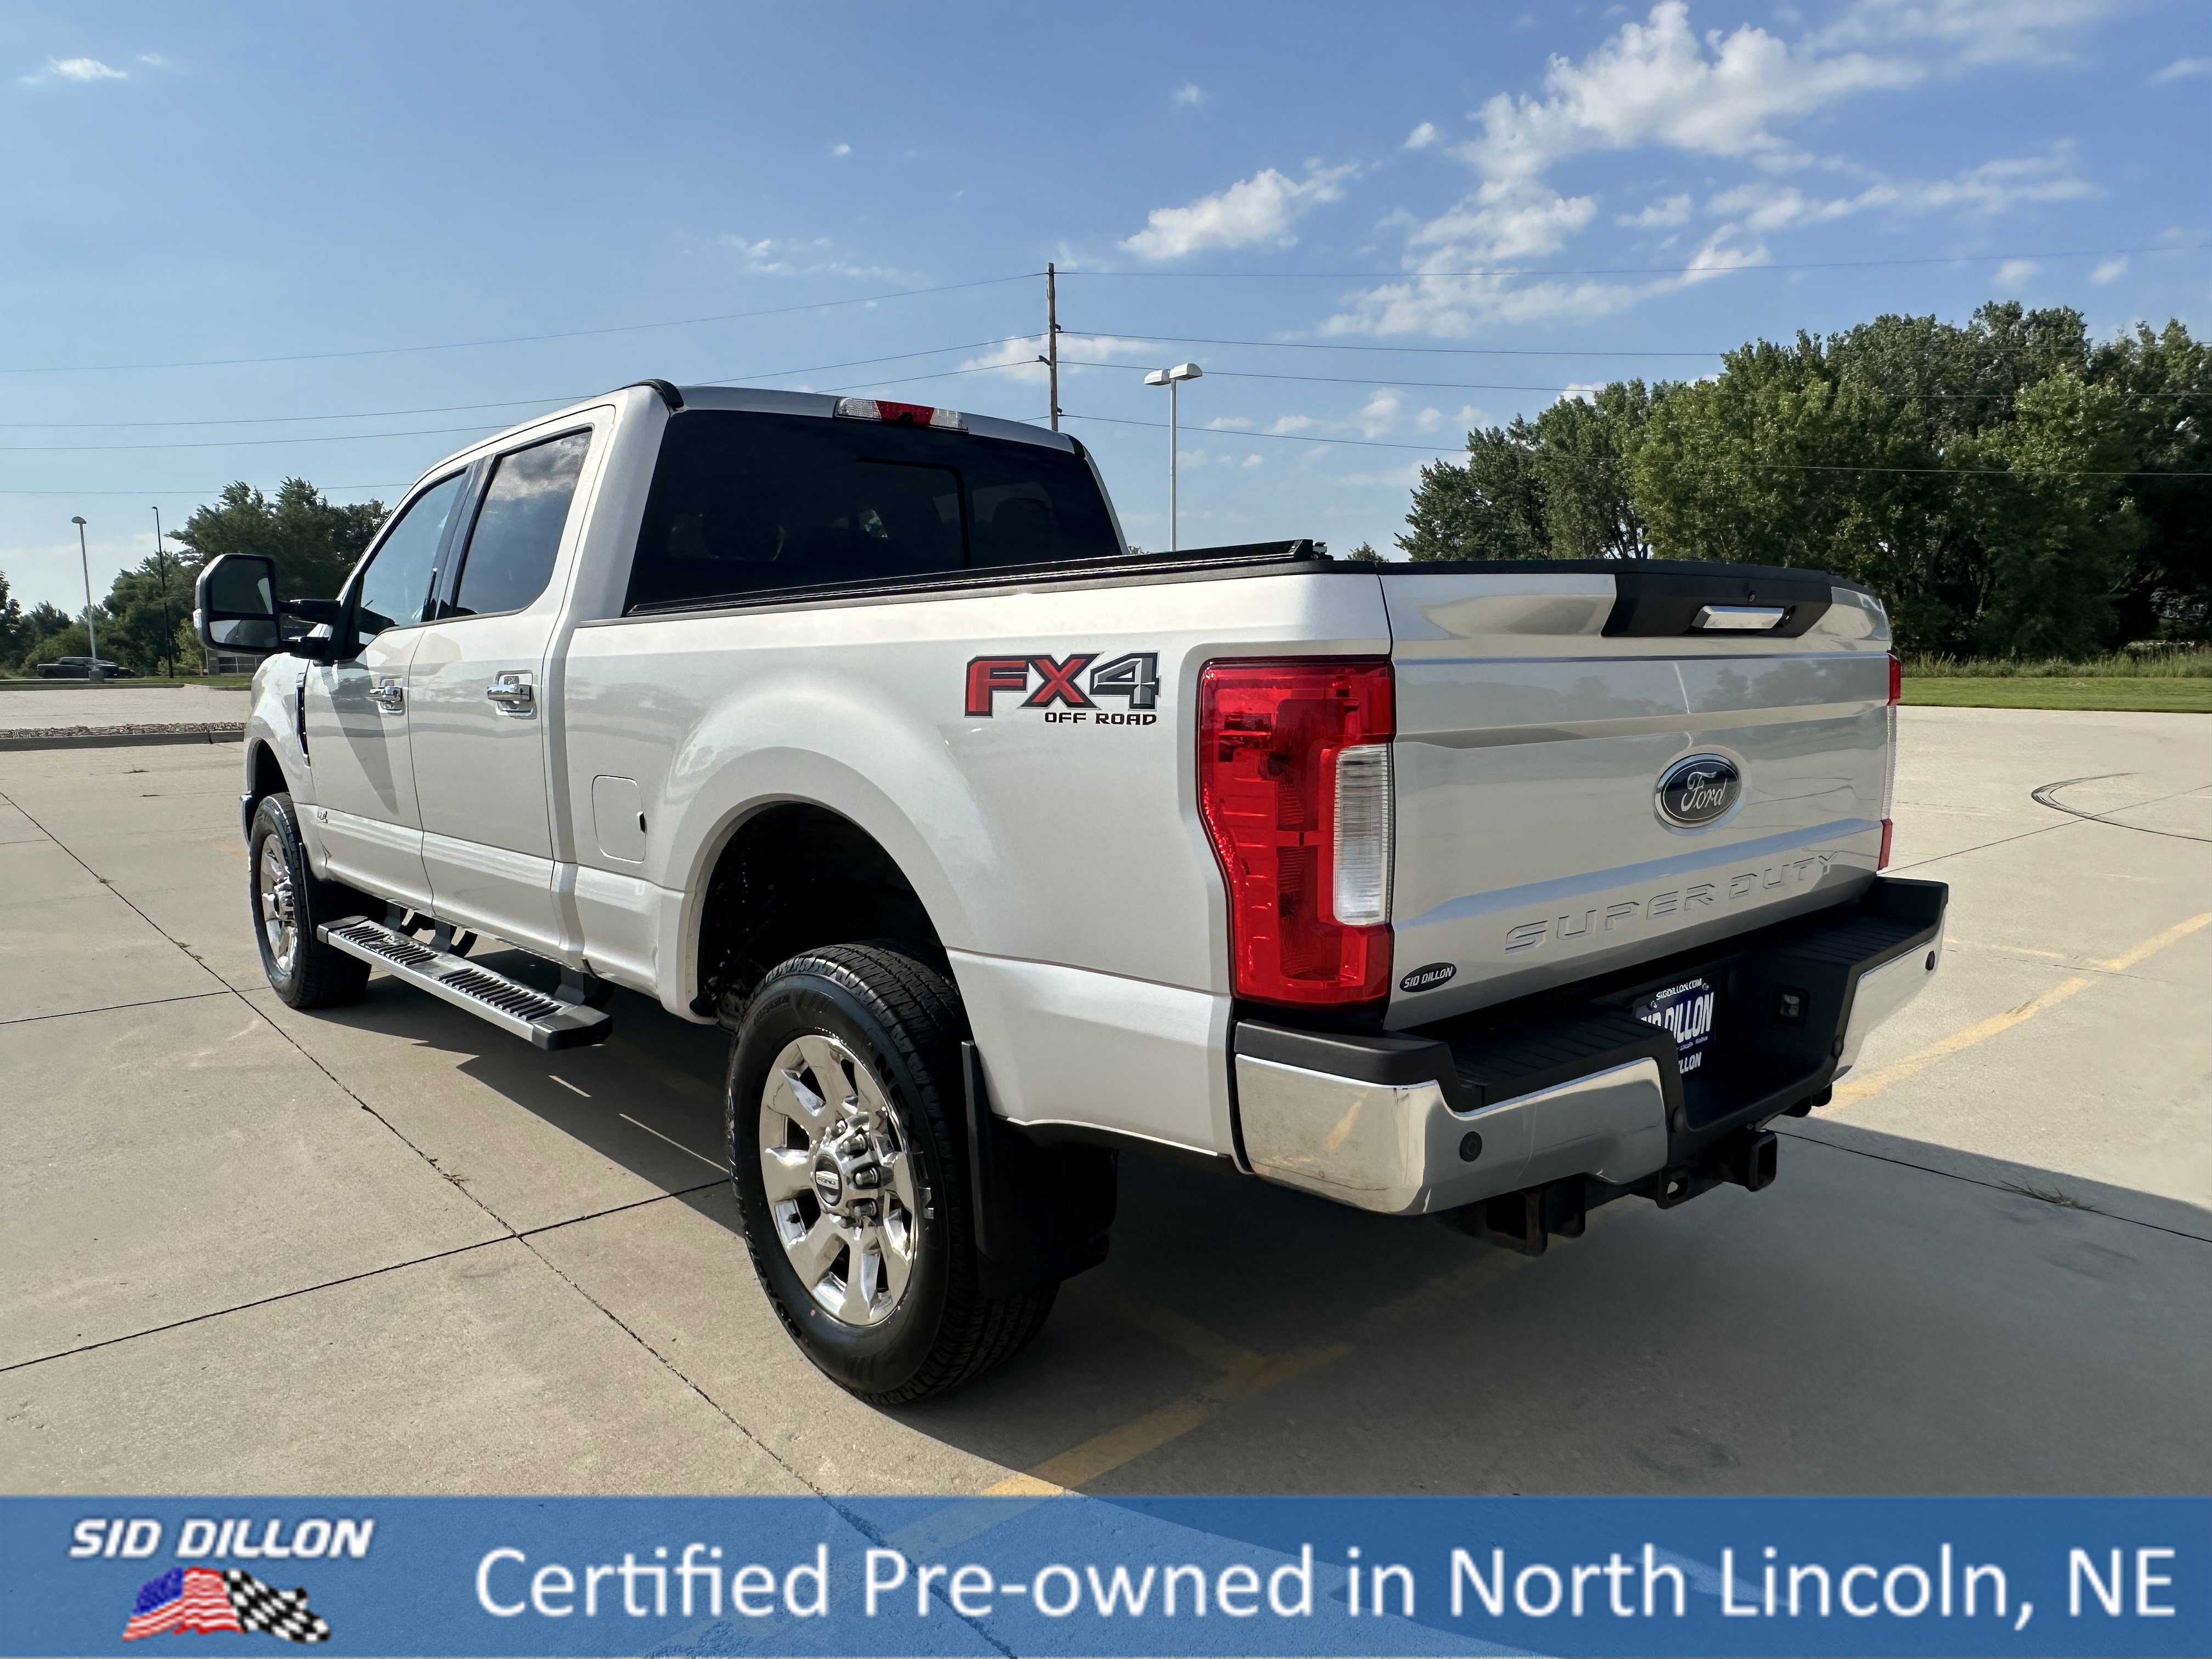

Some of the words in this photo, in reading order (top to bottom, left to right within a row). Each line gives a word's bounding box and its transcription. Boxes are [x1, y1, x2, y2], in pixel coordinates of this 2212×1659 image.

[964, 651, 1161, 718] FX4
[1045, 712, 1087, 724] OFF
[1095, 713, 1157, 725] ROAD
[1680, 771, 1728, 812] Ford
[1504, 883, 1716, 955] SUPER
[1728, 850, 1838, 900] DUTY
[1403, 975, 1420, 989] SID
[1420, 966, 1453, 984] DILLON
[1664, 991, 1714, 1043] DILLON
